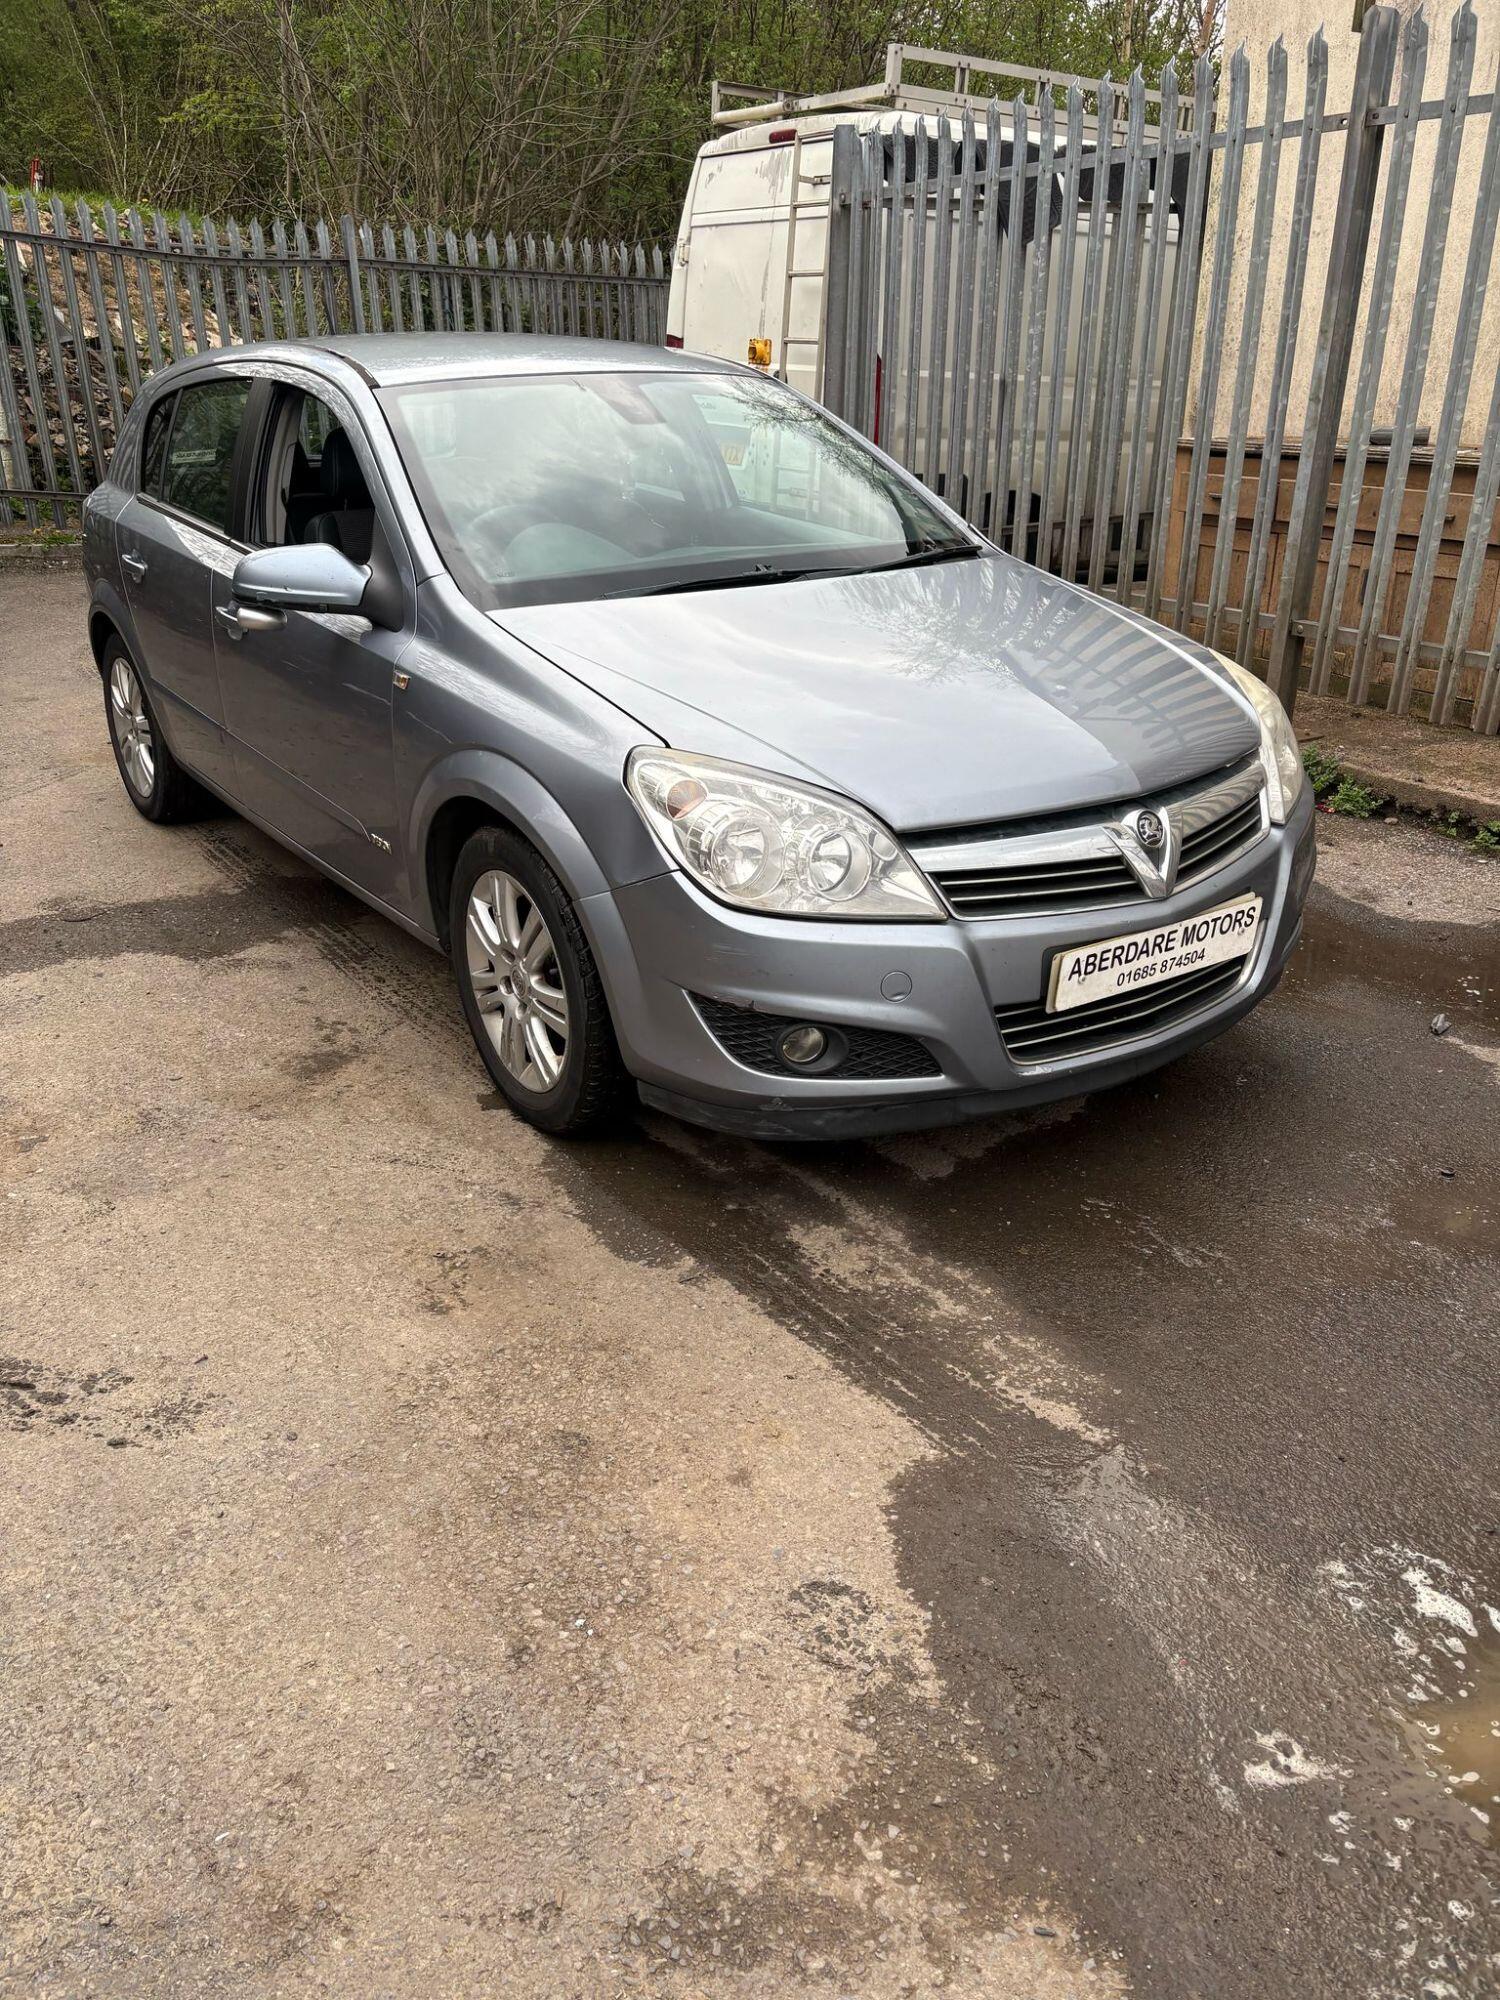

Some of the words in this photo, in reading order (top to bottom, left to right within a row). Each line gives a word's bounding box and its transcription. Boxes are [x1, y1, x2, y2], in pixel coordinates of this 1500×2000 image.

[1067, 929, 1178, 981] ABERDARE
[1180, 906, 1256, 948] MOTORS
[1116, 964, 1156, 987] 01685
[1159, 947, 1206, 974] 874504
